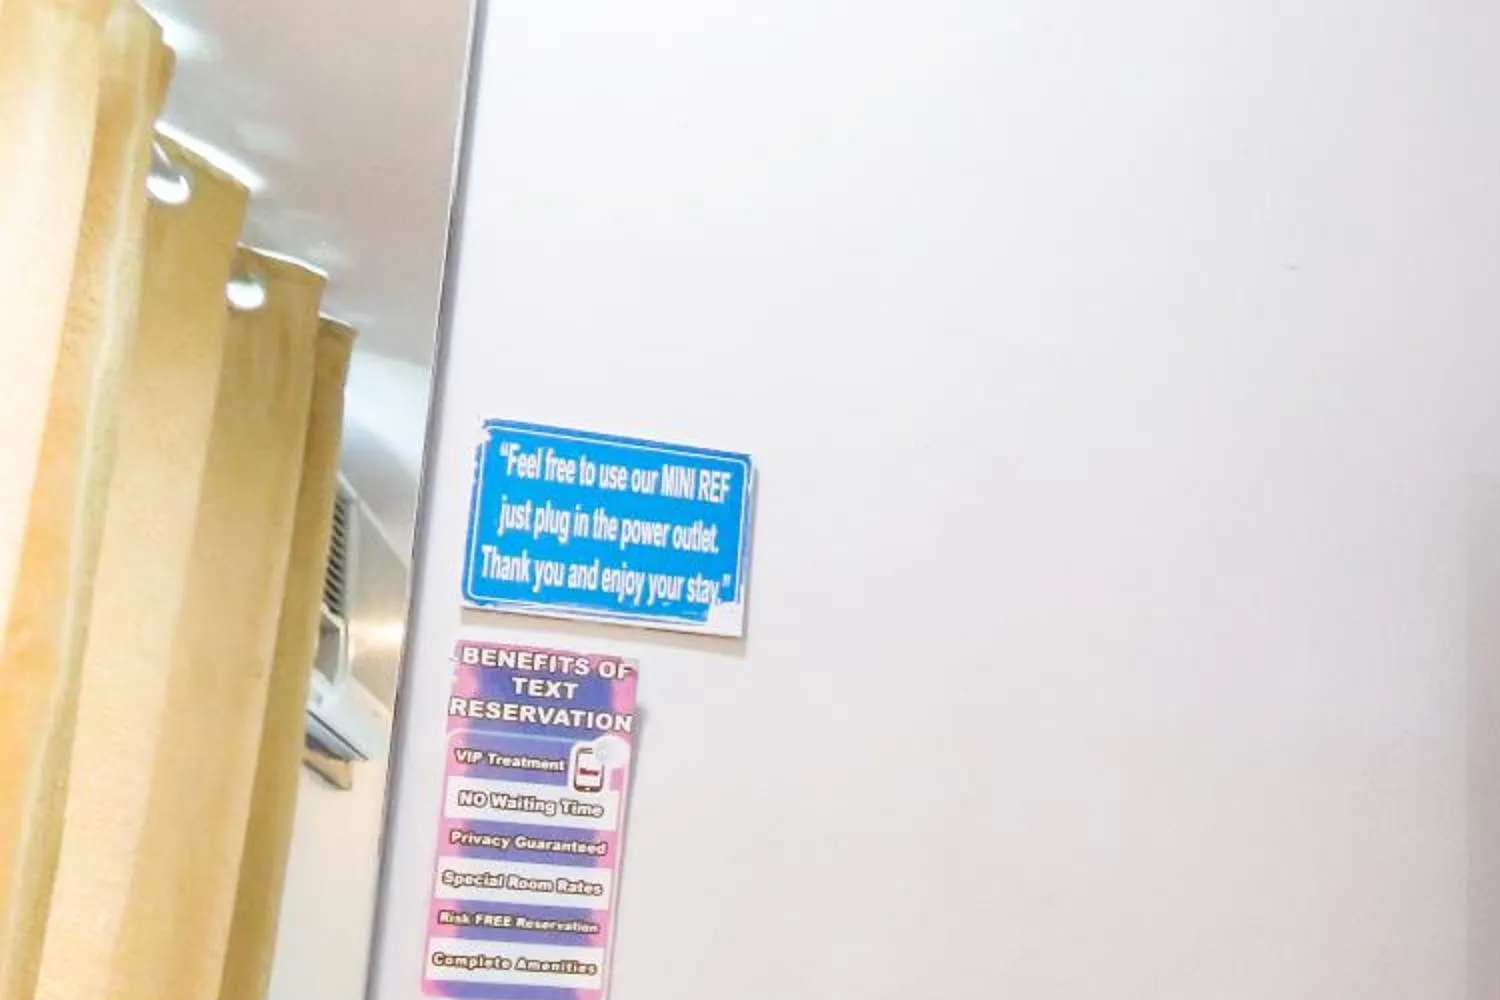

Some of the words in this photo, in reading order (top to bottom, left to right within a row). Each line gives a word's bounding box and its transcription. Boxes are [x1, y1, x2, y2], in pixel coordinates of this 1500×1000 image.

[545, 449, 575, 485] free
[579, 456, 596, 487] to
[601, 465, 627, 490] use
[631, 469, 659, 495] our
[661, 464, 695, 499] MINI
[699, 470, 732, 503] REF
[498, 495, 532, 536] just
[534, 499, 569, 545] plug
[573, 504, 589, 538] in
[593, 507, 616, 541] the
[621, 522, 671, 550] power
[672, 520, 719, 553] outlet.
[481, 545, 531, 582] Thank
[532, 560, 564, 593] you
[568, 559, 598, 590] and
[601, 562, 645, 603] enjoy
[648, 573, 684, 606] your
[462, 647, 590, 676] BENEFITS
[598, 661, 634, 680] OF
[512, 677, 579, 700] TEXT
[450, 698, 633, 732] RESERVATION
[455, 748, 483, 765] VIP
[488, 753, 566, 772] Treatment
[457, 790, 488, 807] NO
[491, 793, 556, 814] Waiting
[560, 800, 604, 817] Time
[450, 830, 510, 850] Privacy
[515, 836, 608, 855] Guaranteed
[442, 870, 504, 890] Special
[507, 874, 553, 893] Room
[556, 878, 604, 897] Rates
[438, 910, 471, 926] Risk
[474, 912, 513, 928] FREE
[515, 914, 600, 934] Reservation
[432, 952, 512, 971] Complete
[514, 956, 598, 975] Amenities
